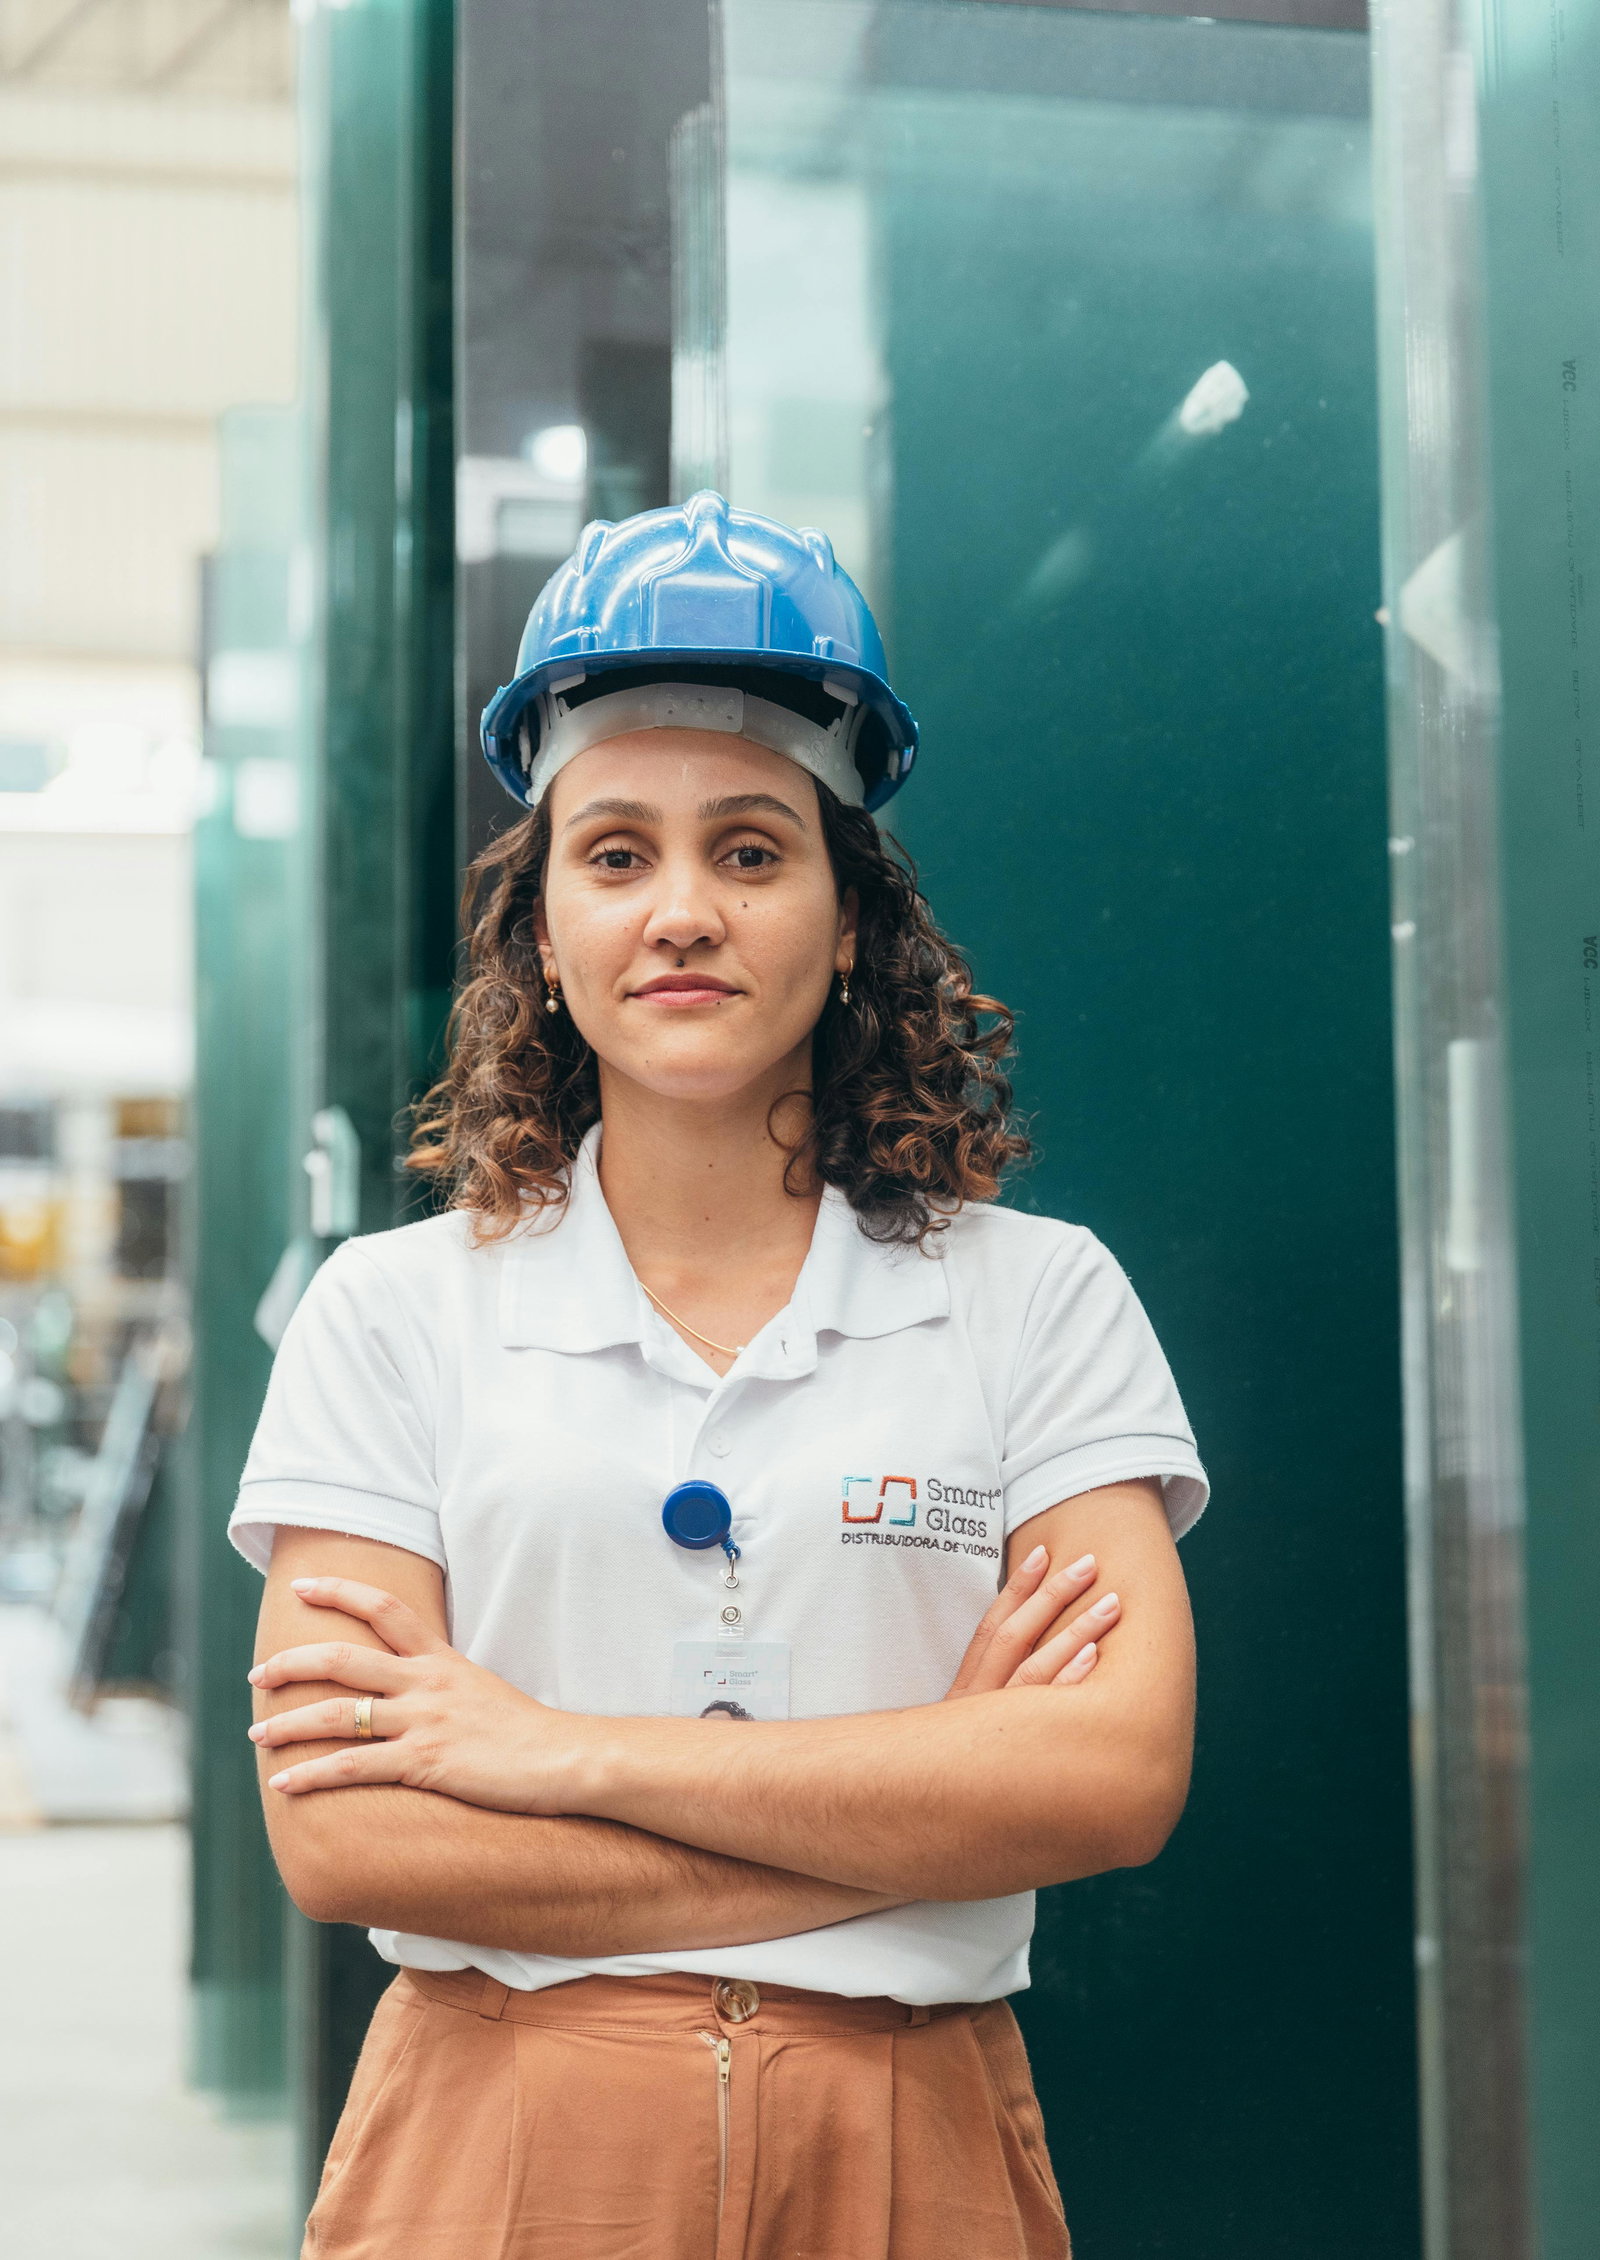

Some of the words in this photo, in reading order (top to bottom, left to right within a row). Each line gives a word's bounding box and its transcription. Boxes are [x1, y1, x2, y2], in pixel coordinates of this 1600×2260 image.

[926, 1508, 987, 1538] Glass
[841, 1532, 939, 1549] DISTRIBUIDORA
[943, 1540, 959, 1553] DE
[963, 1543, 999, 1559] VIDROS
[729, 1678, 751, 1686] Glass
